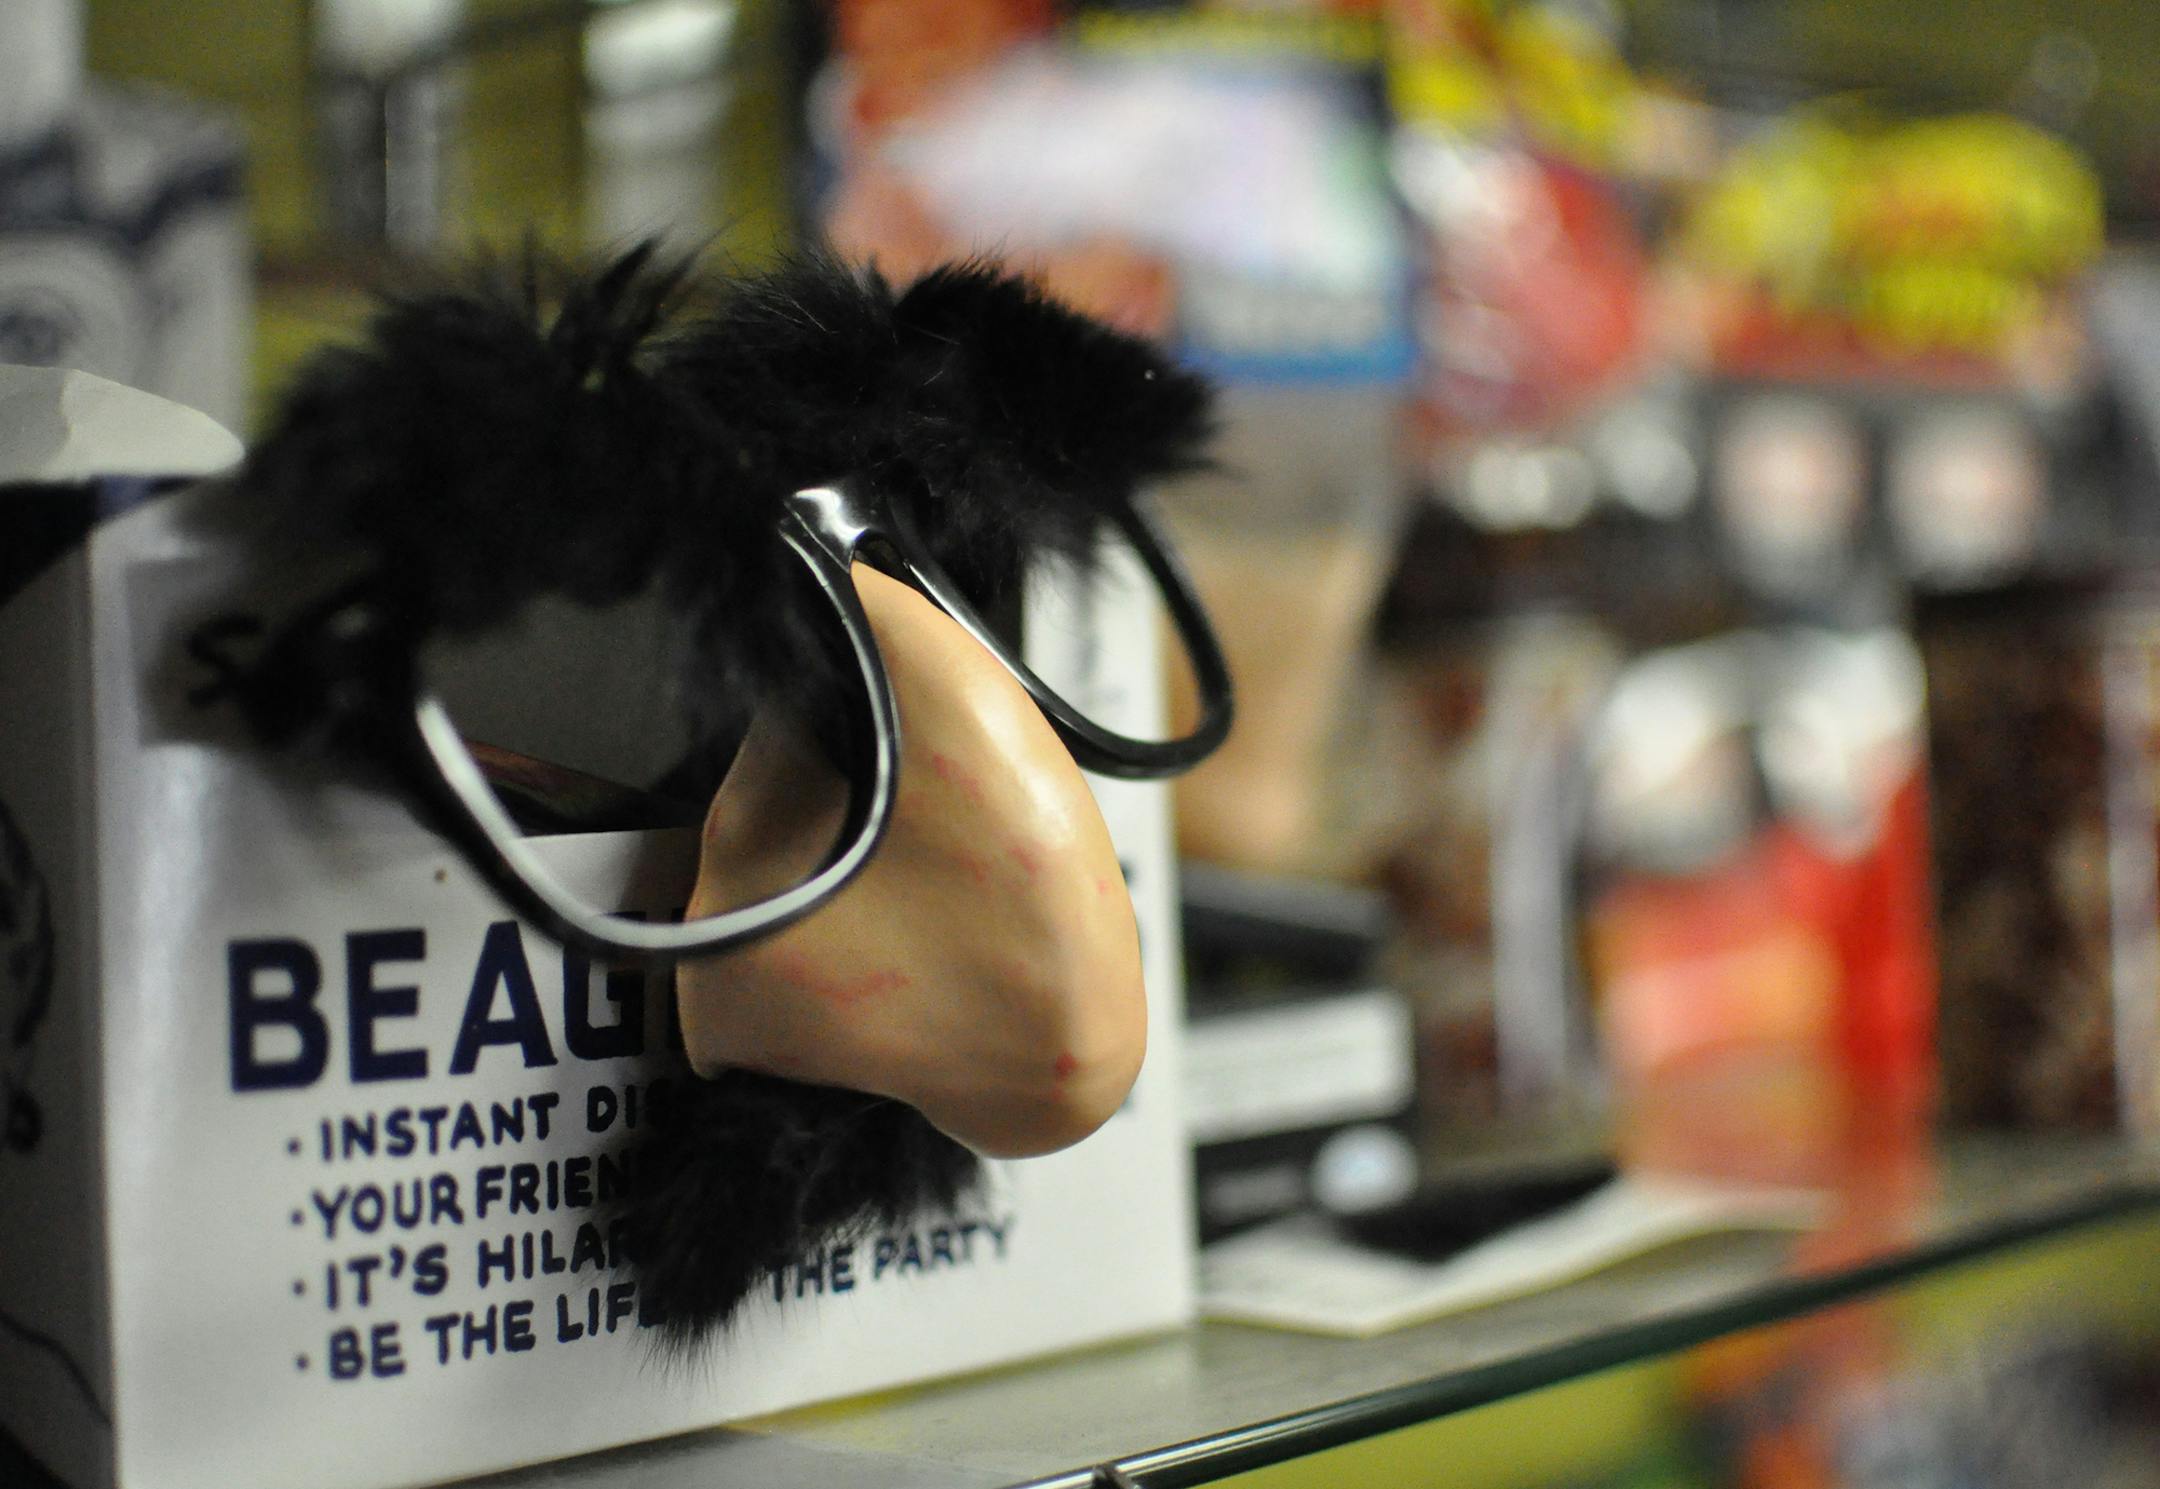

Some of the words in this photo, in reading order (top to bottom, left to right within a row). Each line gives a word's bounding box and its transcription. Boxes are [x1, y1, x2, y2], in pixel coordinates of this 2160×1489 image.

[227, 912, 680, 1093] BEAG
[320, 1092, 560, 1162] INSTANT
[313, 1172, 466, 1240] YOUR
[475, 1152, 635, 1219] FRIEN
[326, 1244, 449, 1311] IT'S
[328, 1321, 407, 1380] BE
[425, 1300, 537, 1366] THE
[768, 1242, 857, 1303] THE
[873, 1216, 1012, 1281] PARTY
